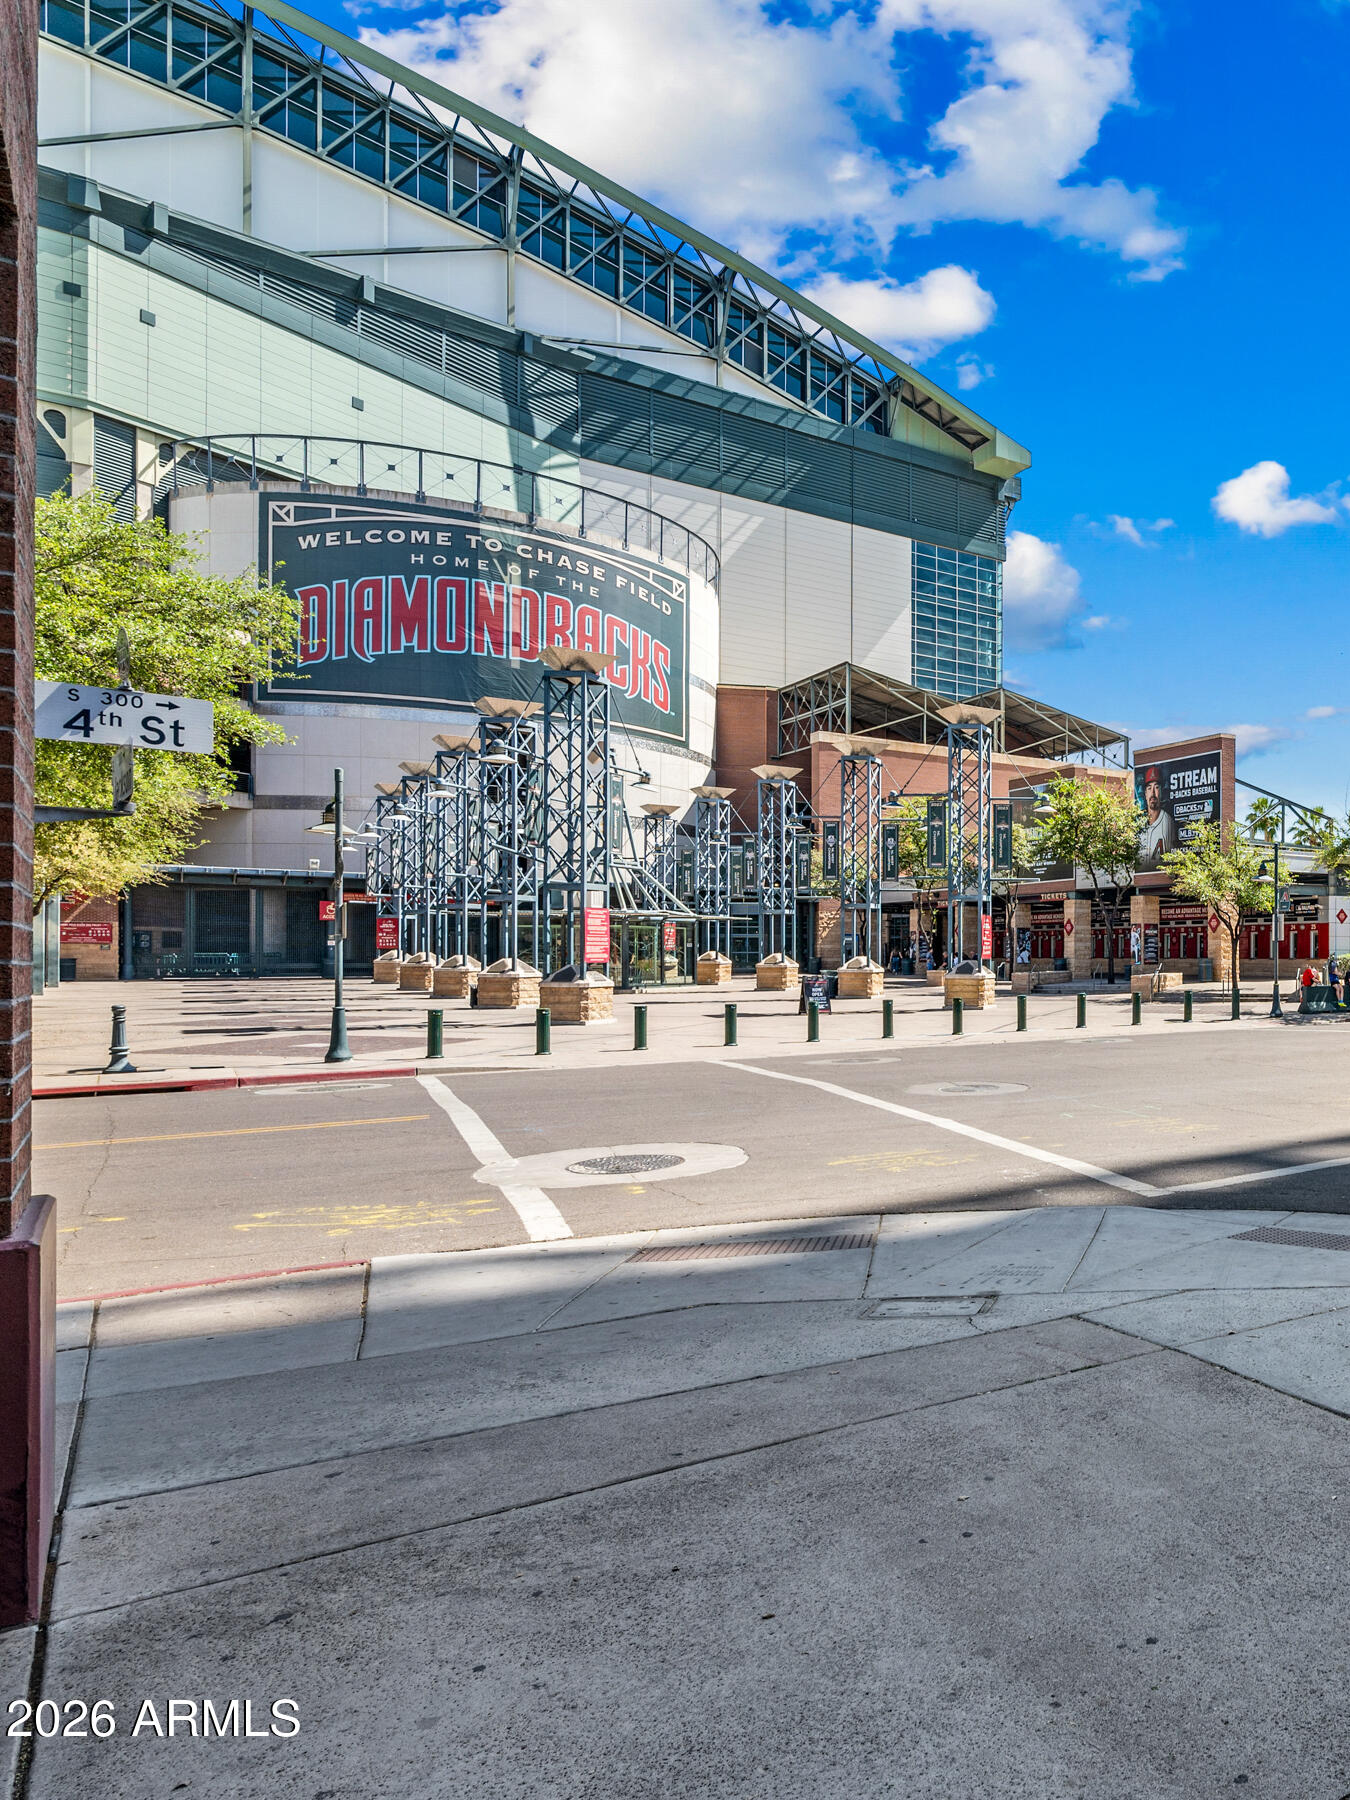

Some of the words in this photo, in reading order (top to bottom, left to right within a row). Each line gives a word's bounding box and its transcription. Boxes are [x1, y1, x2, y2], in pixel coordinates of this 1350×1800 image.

[298, 529, 452, 550] WELCOME
[465, 534, 503, 553] TO
[516, 544, 606, 581] CHASE
[616, 574, 672, 617] FIELD
[411, 553, 489, 571] HOME
[509, 564, 539, 580] OF
[556, 575, 600, 599] THE
[295, 574, 671, 715] DIAMONDBACKS
[67, 688, 80, 702] S
[101, 692, 143, 709] 300
[63, 708, 123, 738] 4th
[140, 715, 185, 748] St
[1169, 788, 1191, 799] D-BACKS
[1192, 784, 1218, 796] BASEBALL
[1170, 766, 1218, 790] STREAM
[1041, 892, 1067, 900] TICKETS
